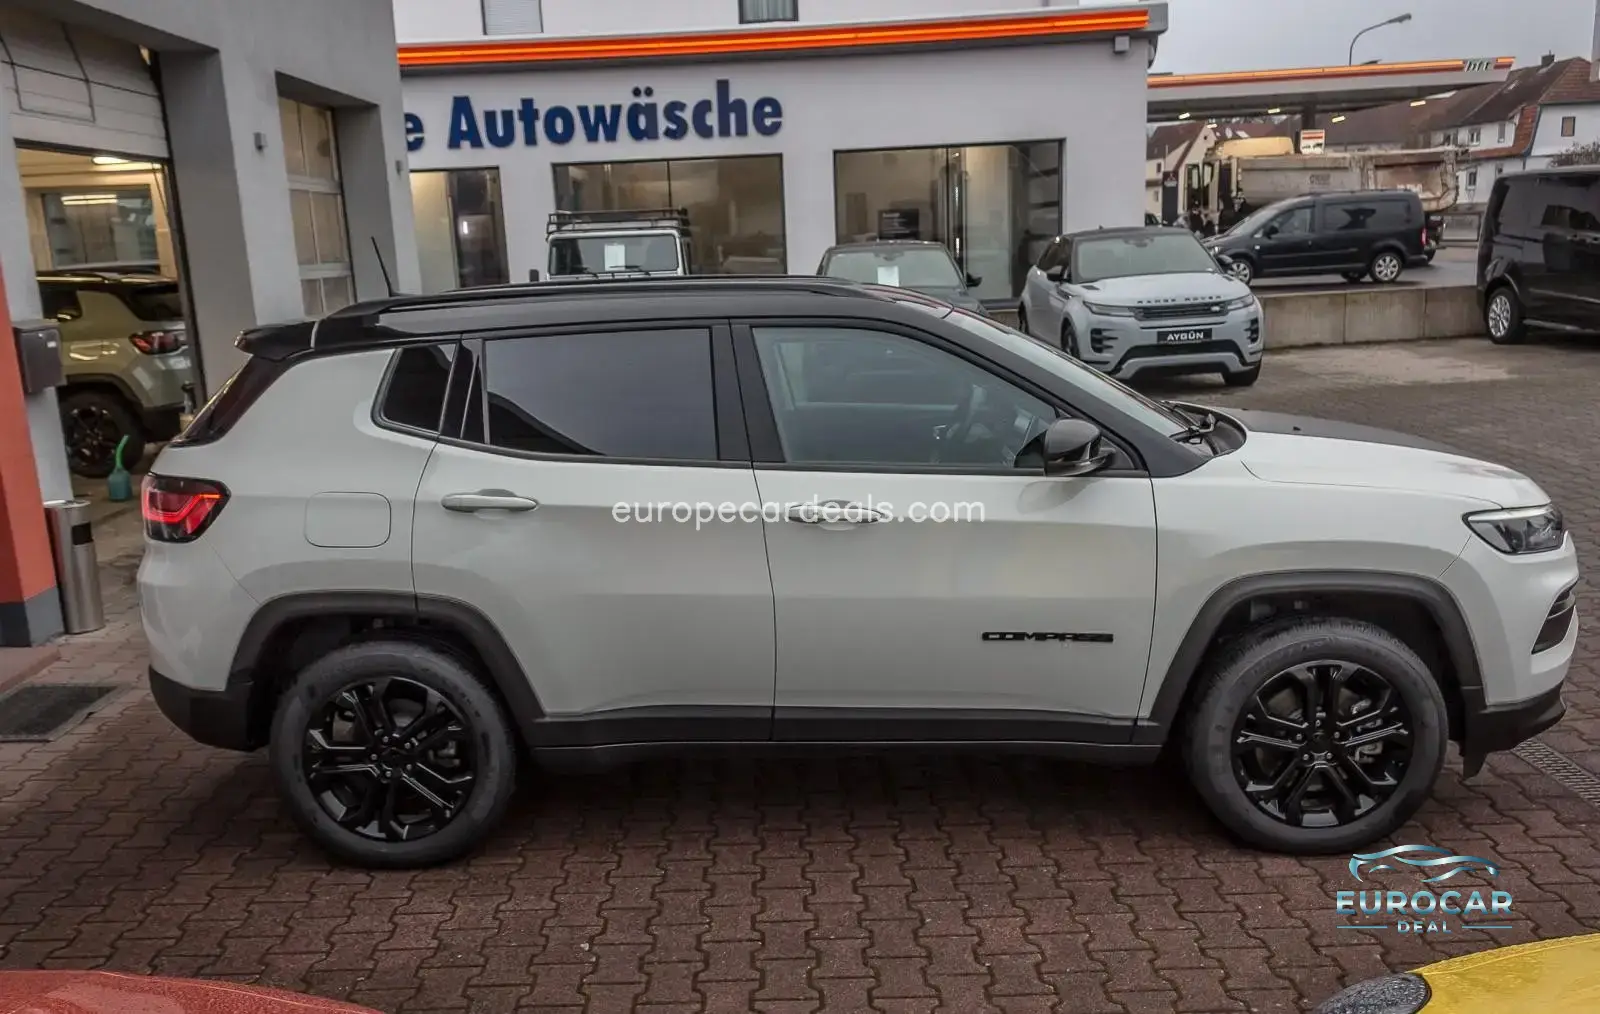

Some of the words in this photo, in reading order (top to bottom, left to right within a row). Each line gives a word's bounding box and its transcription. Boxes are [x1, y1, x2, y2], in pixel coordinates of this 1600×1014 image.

[447, 79, 783, 150] Autowäsche
[1166, 331, 1204, 342] AYGÜN
[981, 631, 1114, 643] COMPASS
